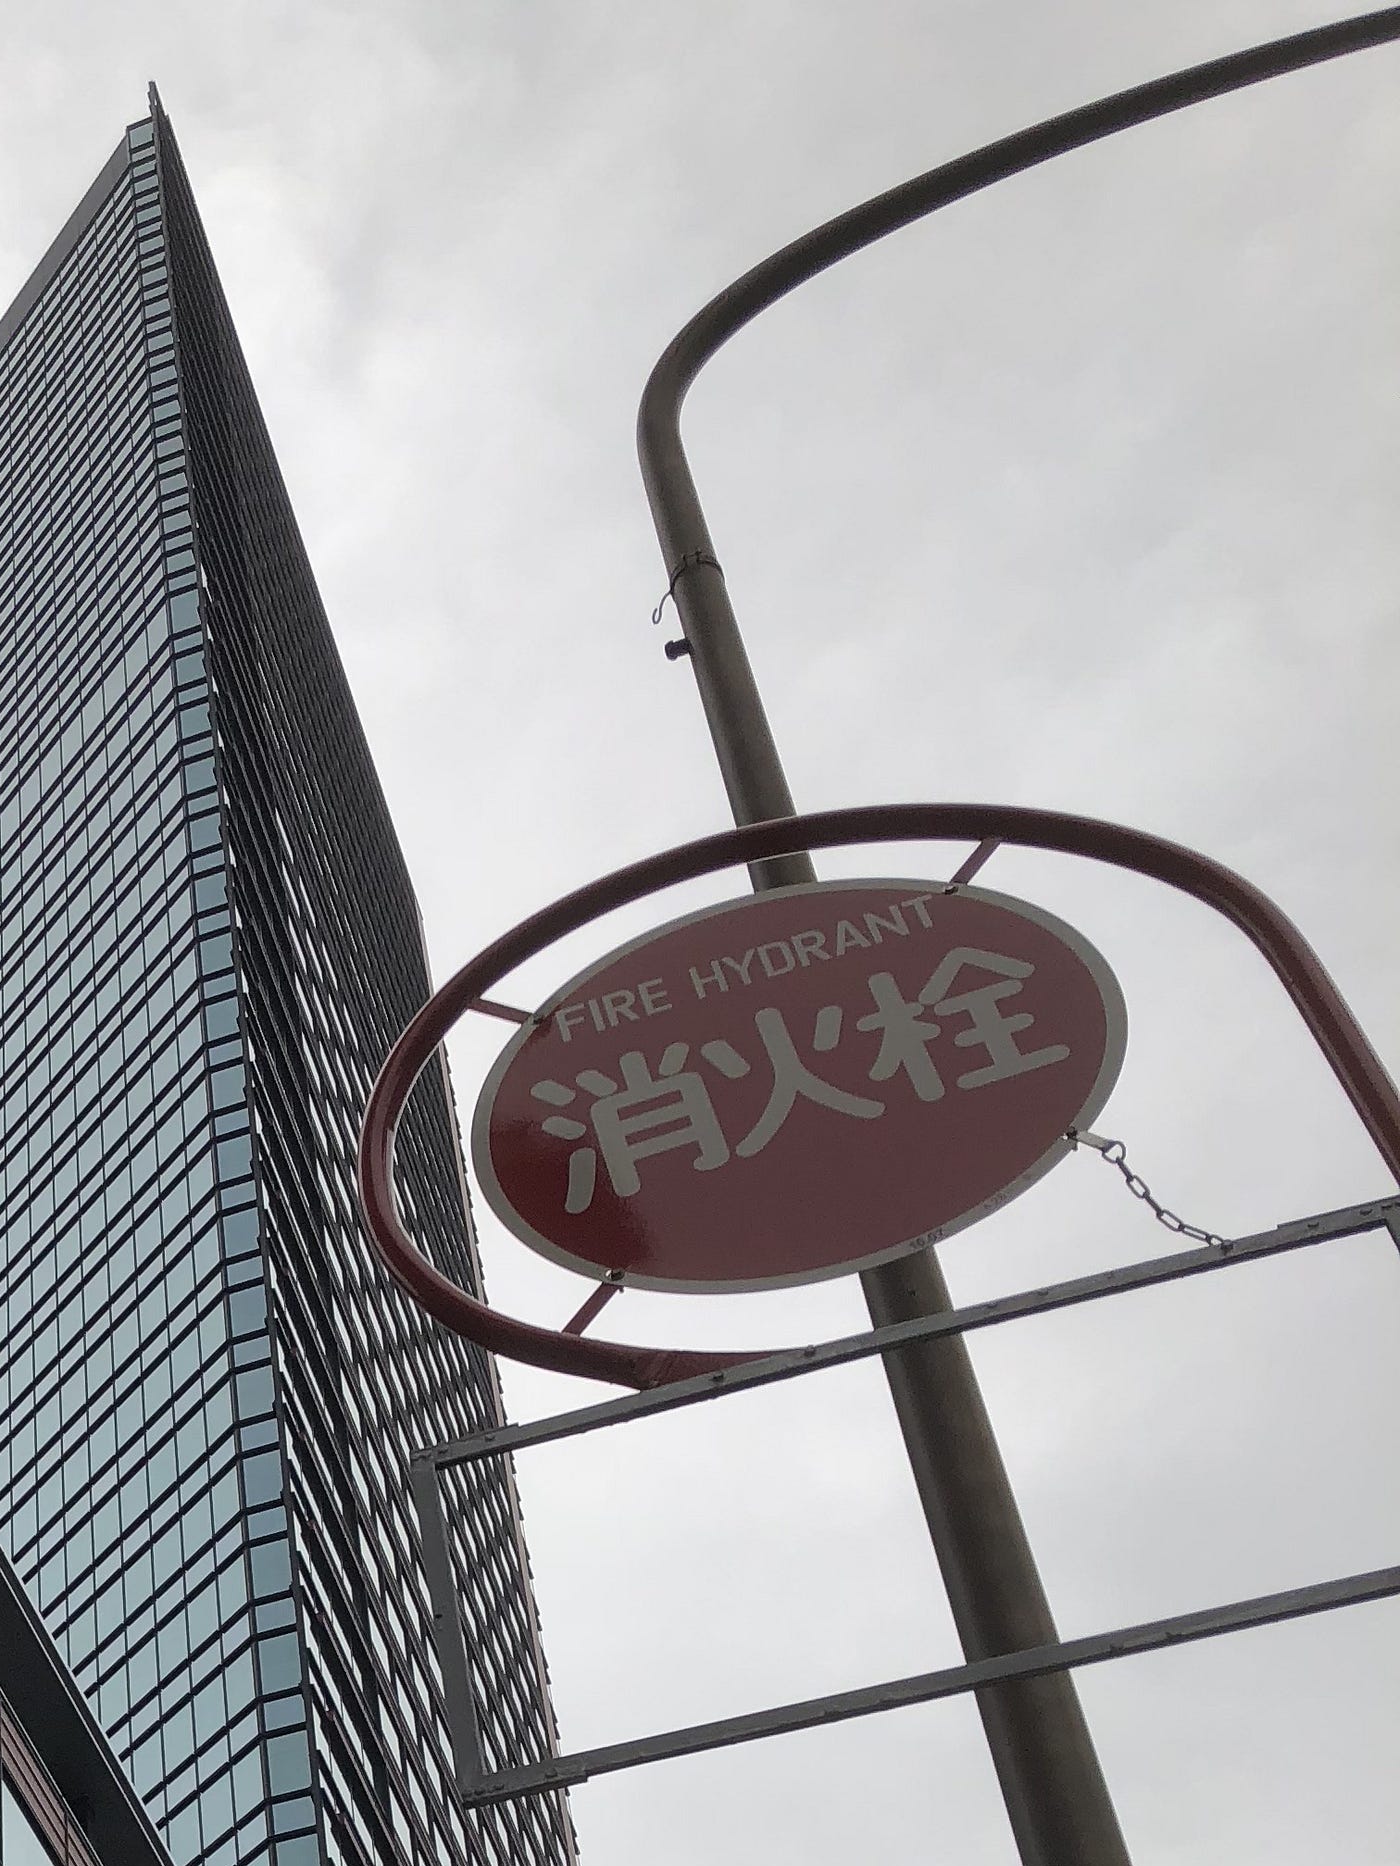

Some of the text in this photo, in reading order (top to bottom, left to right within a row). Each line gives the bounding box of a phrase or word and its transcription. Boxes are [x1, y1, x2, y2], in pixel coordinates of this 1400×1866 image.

[554, 894, 933, 1042] FIRE HYDRANT
[531, 946, 1071, 1214] 消火栓
